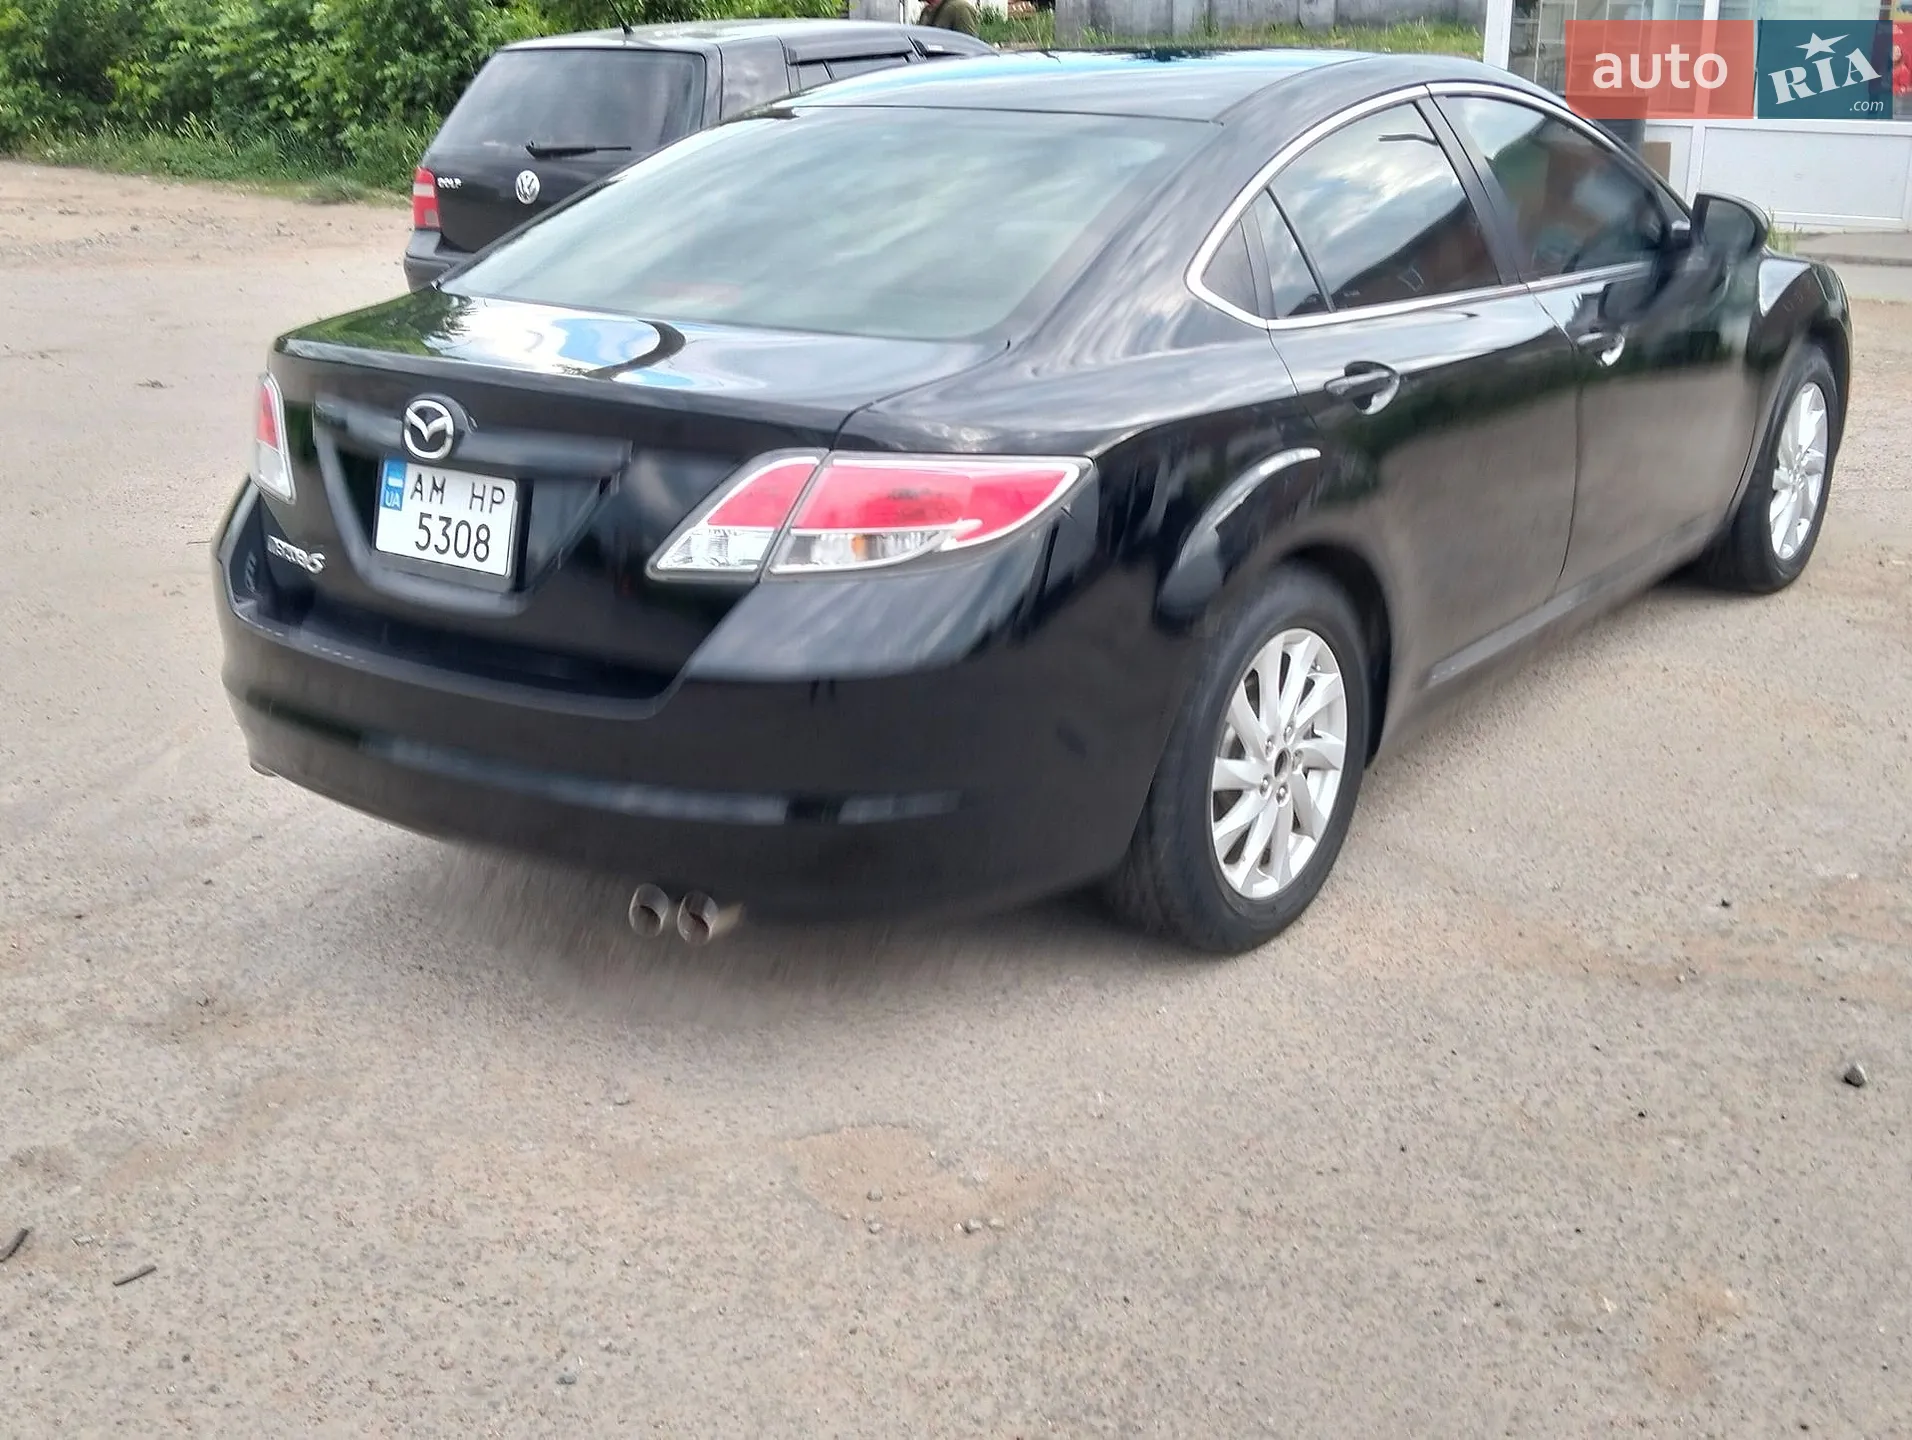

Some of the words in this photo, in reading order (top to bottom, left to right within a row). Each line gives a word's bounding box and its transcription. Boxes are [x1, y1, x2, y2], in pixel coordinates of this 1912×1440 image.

[384, 490, 401, 507] UA
[410, 472, 446, 505] AM
[469, 481, 505, 514] HP
[414, 511, 491, 563] 5308
